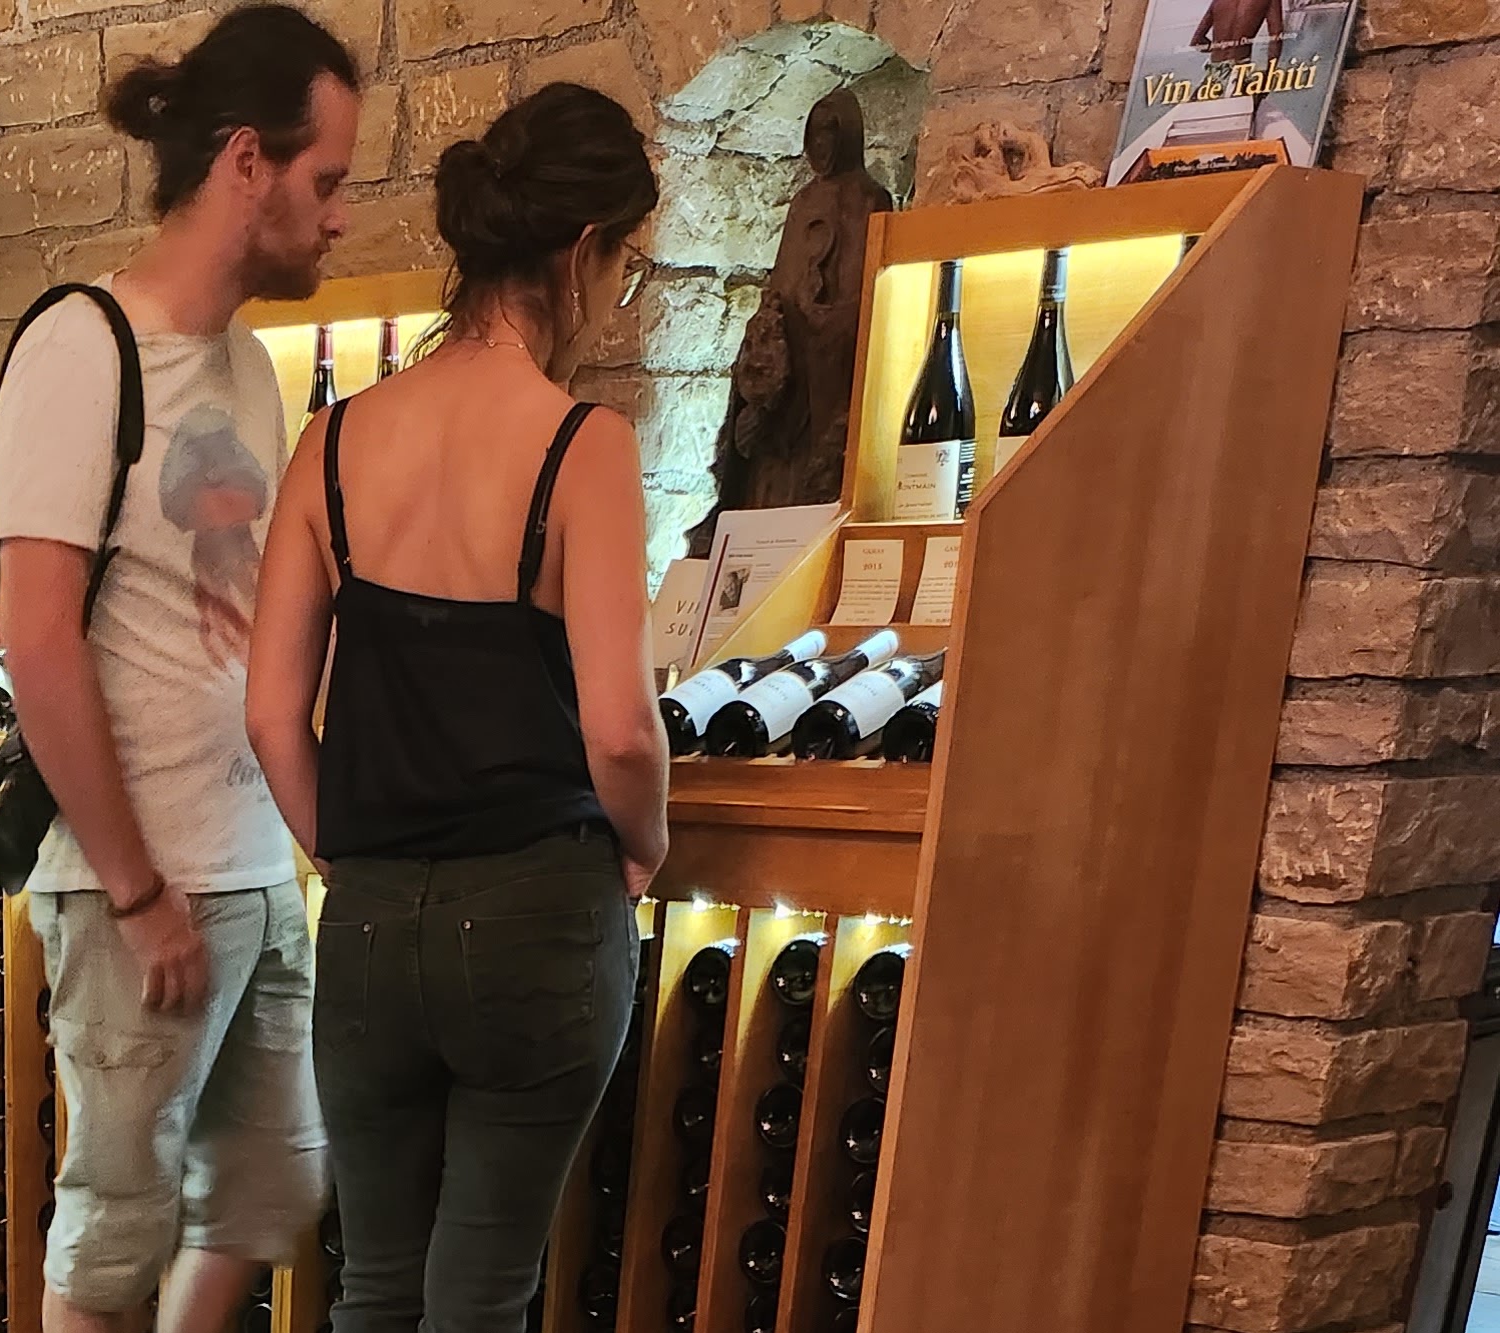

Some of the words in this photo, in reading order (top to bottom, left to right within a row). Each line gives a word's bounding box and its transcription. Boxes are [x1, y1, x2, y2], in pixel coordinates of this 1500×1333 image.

[1144, 71, 1191, 107] Vin
[1197, 77, 1222, 101] de
[1233, 54, 1320, 97] Tahiti
